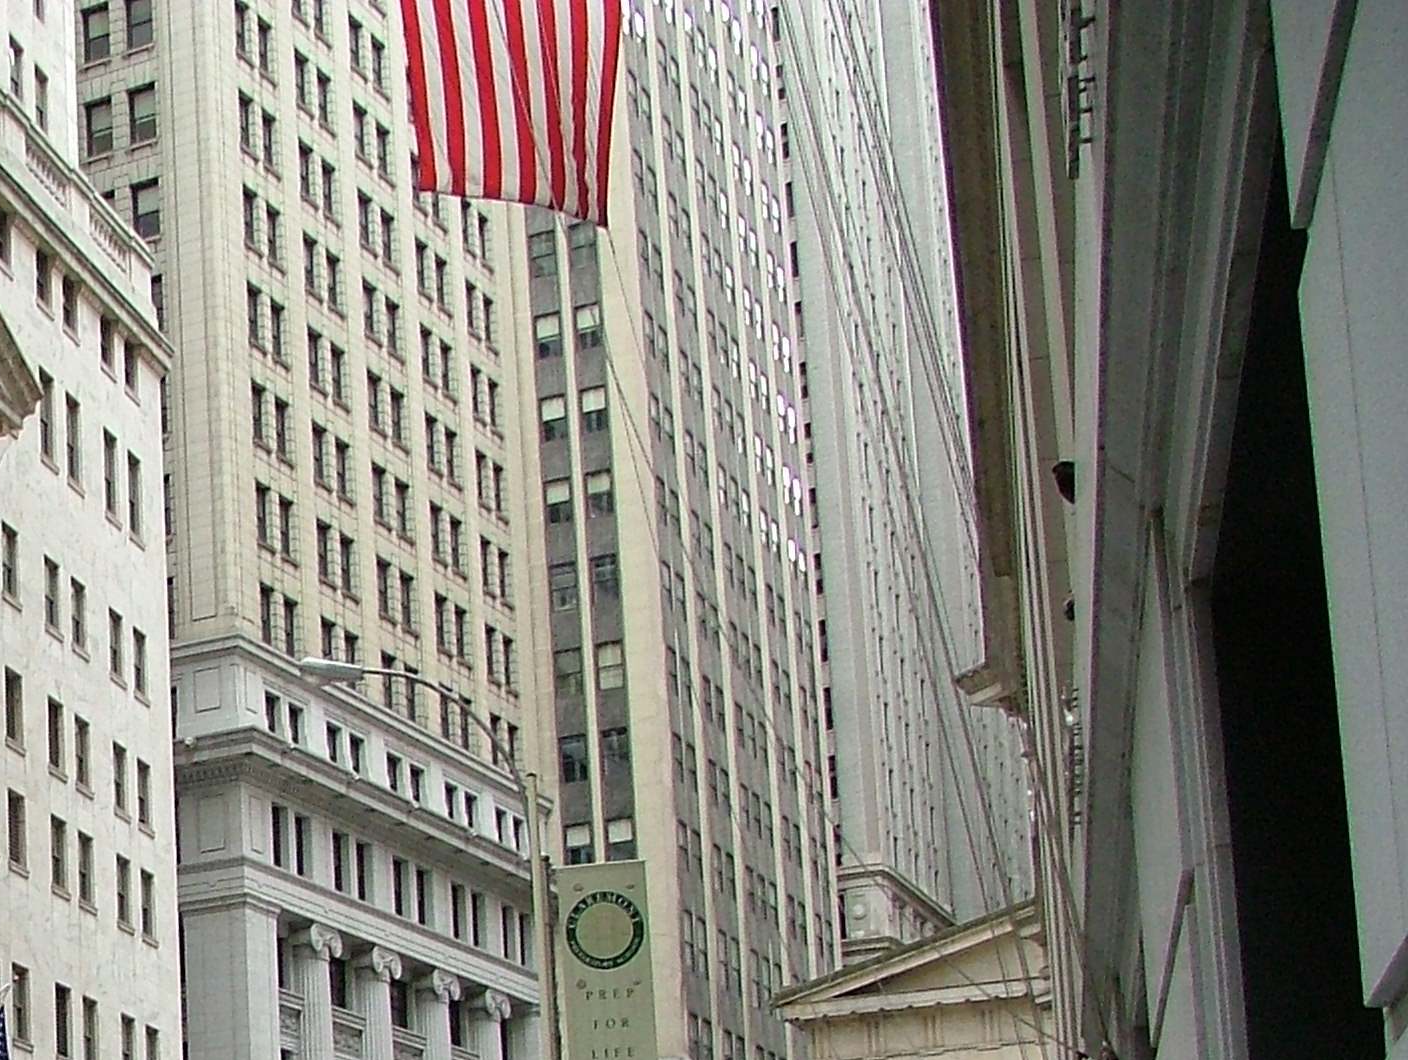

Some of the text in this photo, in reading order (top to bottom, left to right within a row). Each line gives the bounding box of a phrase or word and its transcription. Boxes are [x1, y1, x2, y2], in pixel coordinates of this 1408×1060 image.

[586, 987, 634, 1001] PREP
[594, 1017, 630, 1030] FOR
[592, 1047, 635, 1060] LIFE
